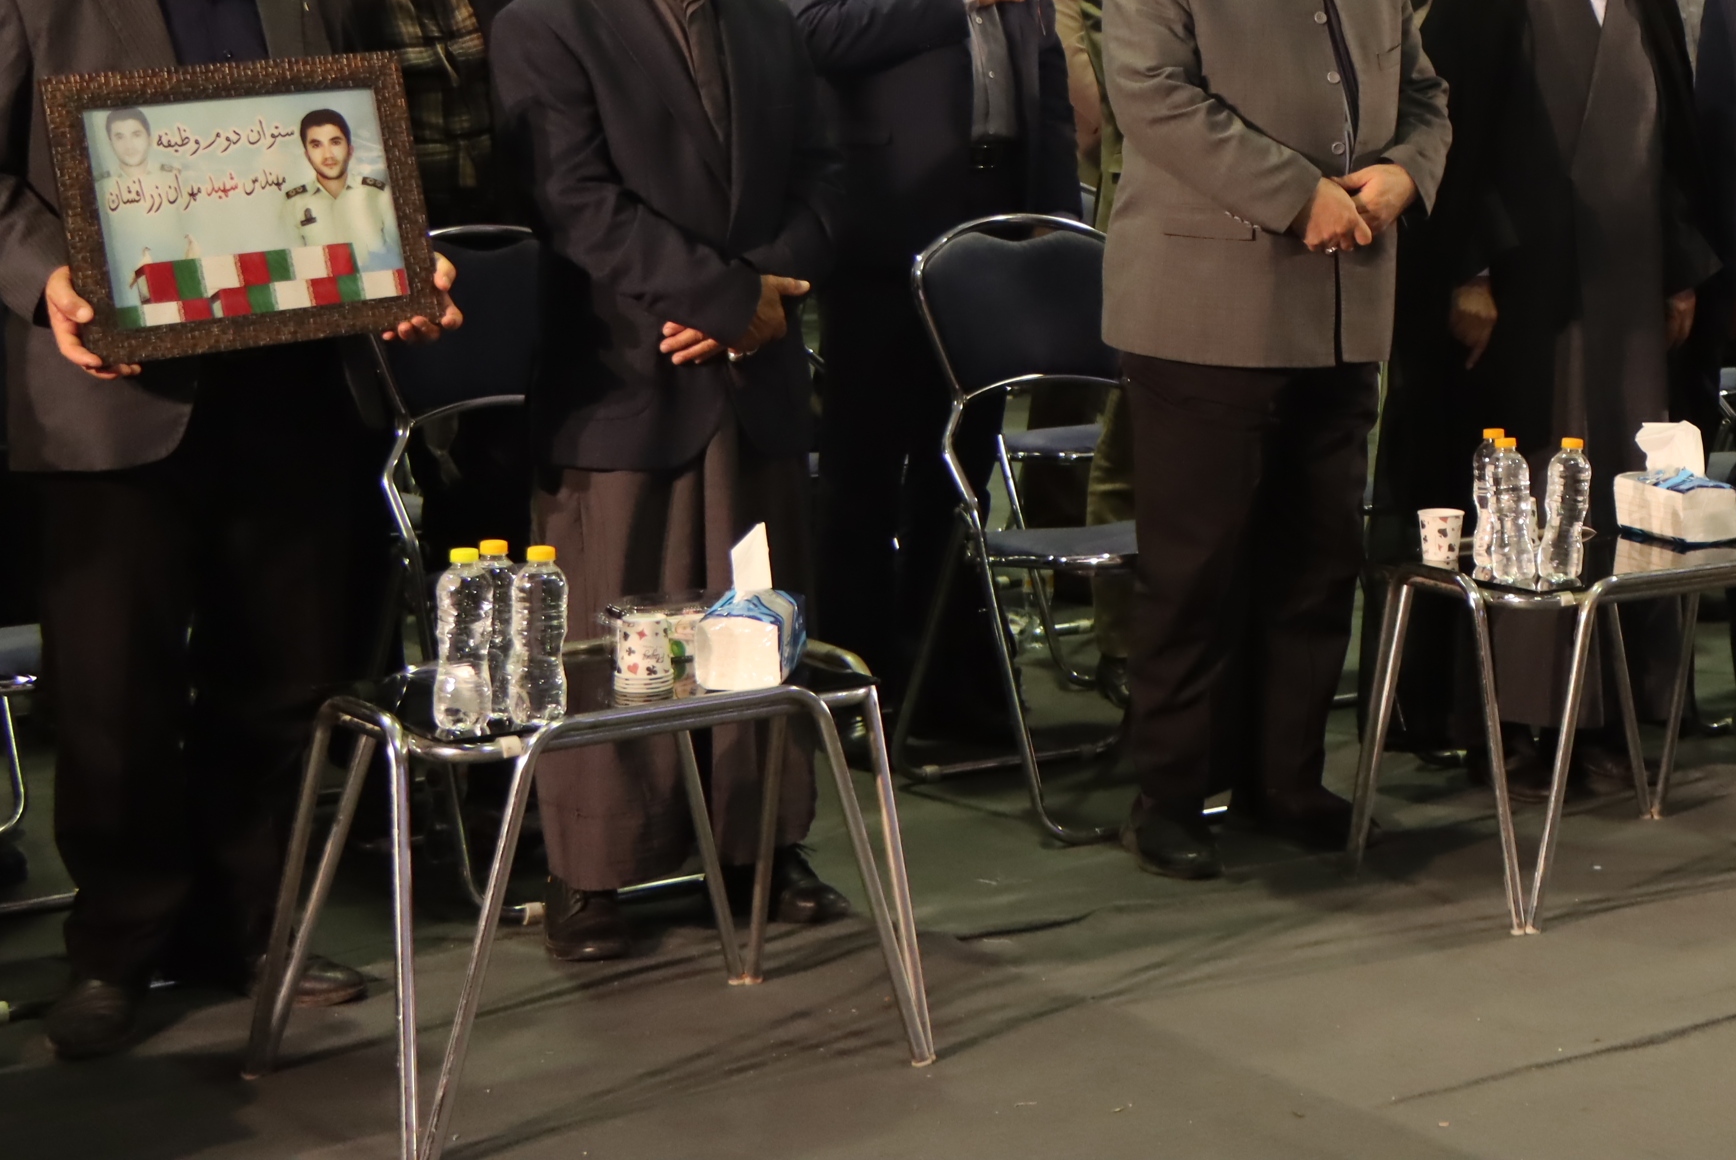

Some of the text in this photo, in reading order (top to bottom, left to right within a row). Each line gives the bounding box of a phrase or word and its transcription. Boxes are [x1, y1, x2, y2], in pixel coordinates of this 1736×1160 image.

[156, 119, 295, 157] ستوان دوم وظیفه
[166, 173, 202, 211] مهران
[205, 172, 239, 200] شهید
[243, 169, 287, 196] مهندس
